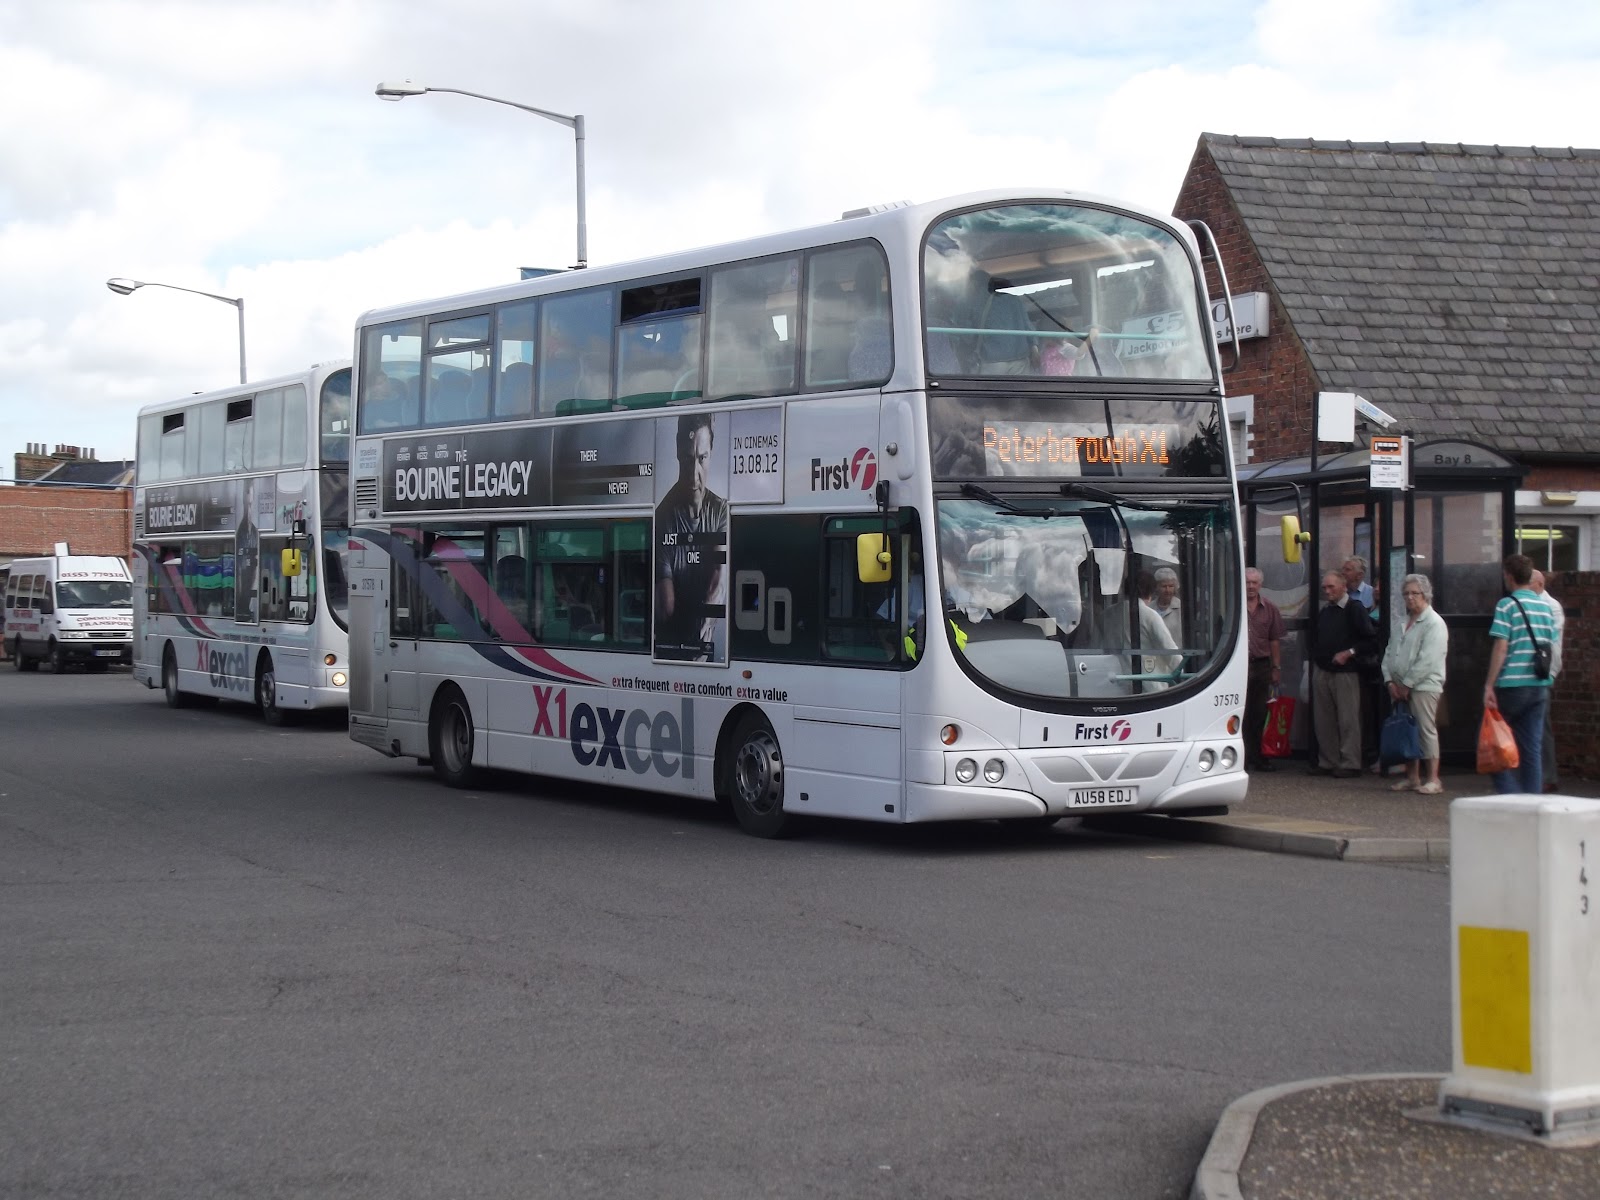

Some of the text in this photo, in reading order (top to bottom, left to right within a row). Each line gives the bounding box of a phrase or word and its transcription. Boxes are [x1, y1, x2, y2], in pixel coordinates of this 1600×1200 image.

[734, 435, 778, 450] IN CINEMAS
[983, 427, 1169, 464] Peterborough X1
[455, 450, 468, 462] THE
[580, 450, 598, 462] THERE
[733, 453, 778, 475] 13.08.12
[1435, 454, 1472, 466] Bay 8
[639, 464, 652, 476] WAS
[811, 458, 849, 491] First
[396, 461, 532, 501] BOURNE LEGACY
[608, 482, 628, 495] NEVER
[174, 503, 197, 526] LEGACY
[662, 533, 678, 546] JUST
[687, 551, 700, 564] ONE
[209, 644, 250, 692] excel
[612, 676, 788, 702] extra frequent extra comfort extra value
[1213, 693, 1240, 707] 37578
[532, 685, 694, 779] X1 excel
[1075, 723, 1109, 741] First
[1074, 788, 1132, 806] AU58 EDJ
